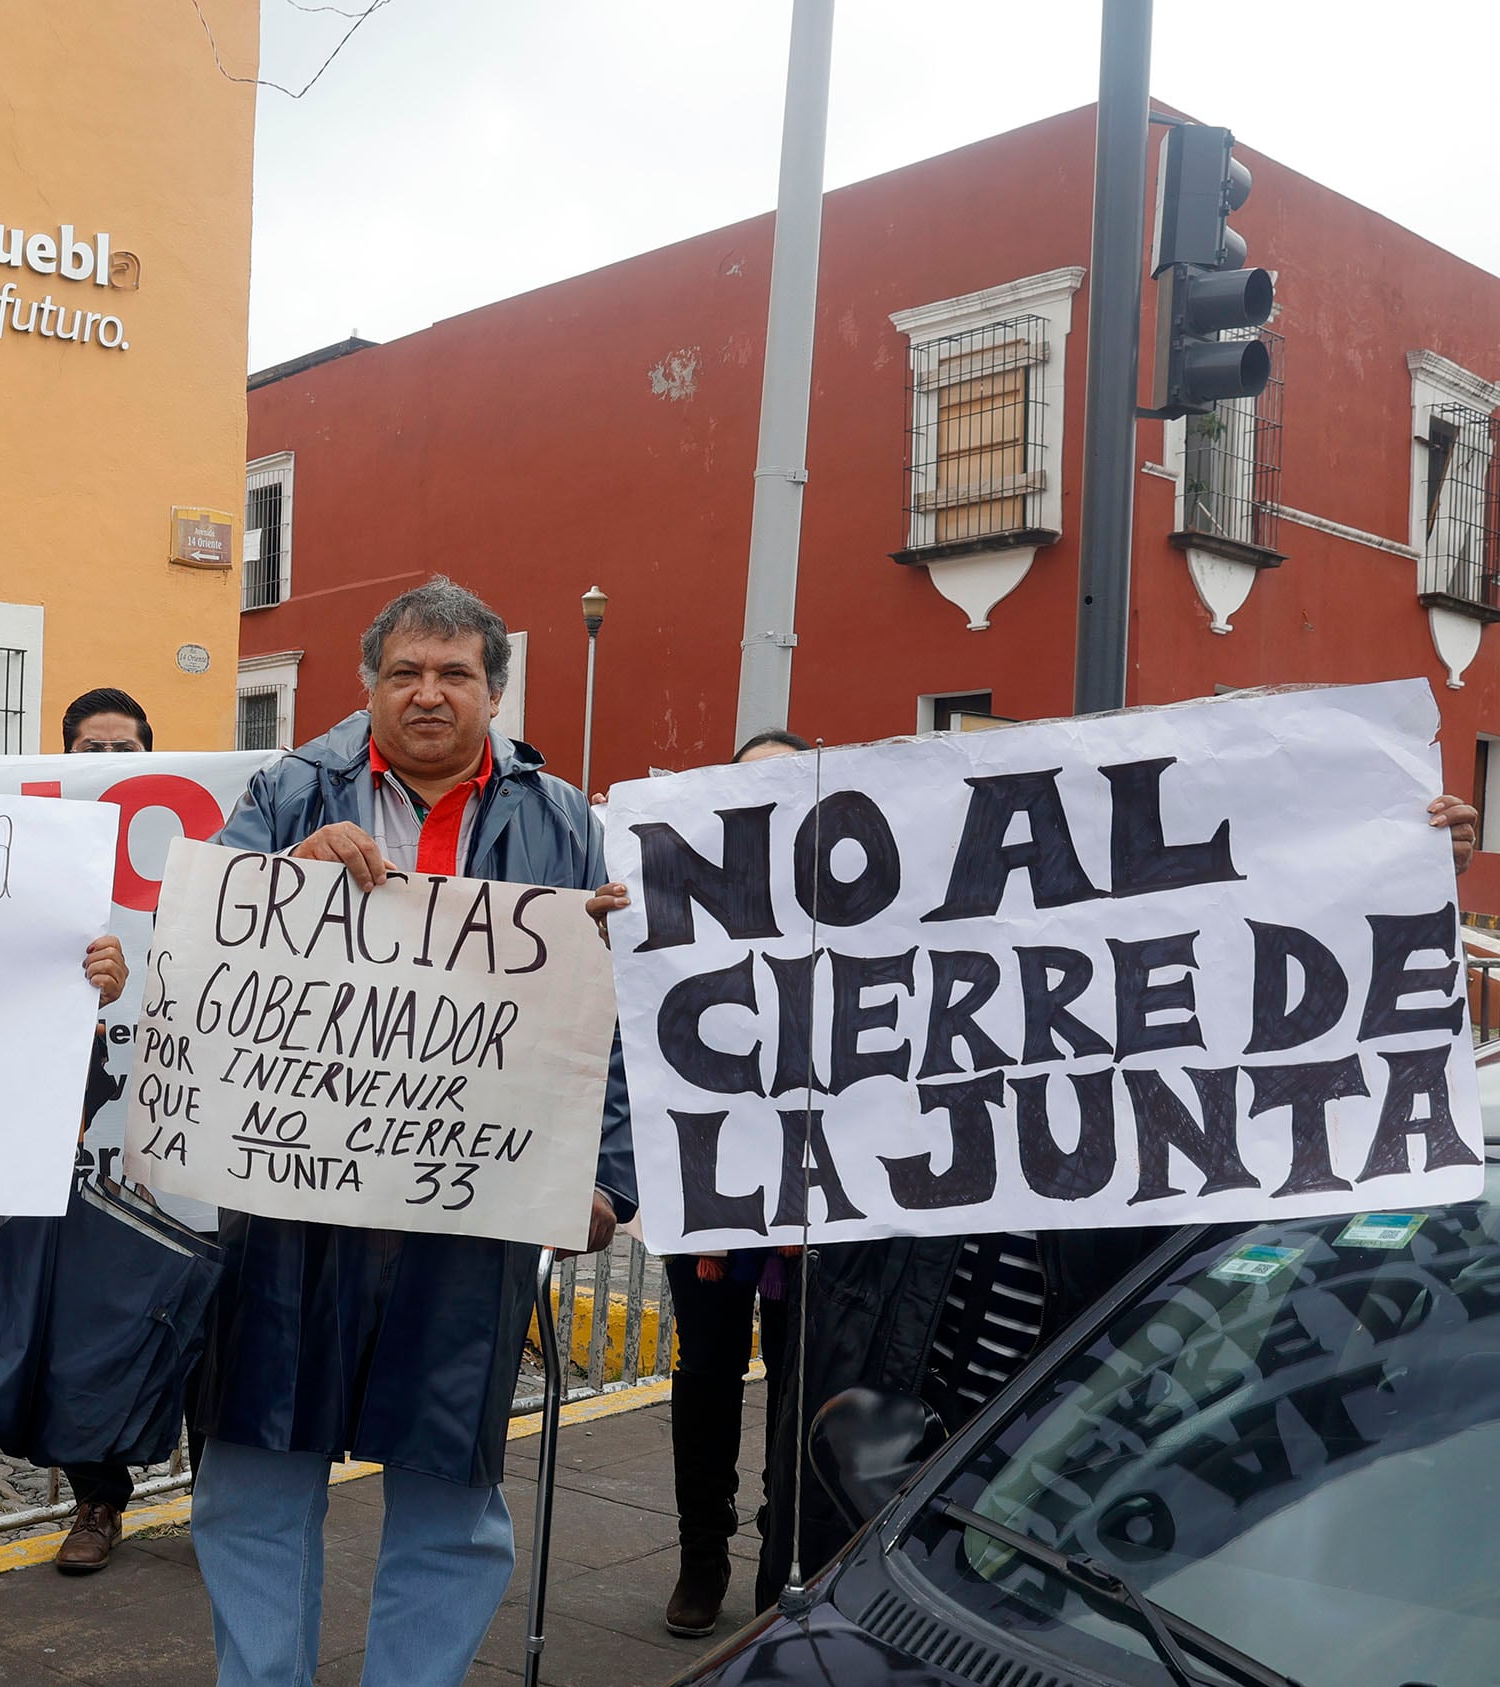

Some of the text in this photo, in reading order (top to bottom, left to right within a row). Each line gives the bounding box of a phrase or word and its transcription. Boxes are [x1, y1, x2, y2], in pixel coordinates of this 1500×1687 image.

[188, 536, 222, 550] 14 Oriente
[629, 756, 1247, 953] NO AL
[215, 852, 557, 975] GRACIAS
[196, 961, 520, 1070] GOBERNADOR
[657, 902, 1465, 1098] CIERRE DE
[139, 1073, 202, 1124] QUE
[241, 1101, 309, 1143] NO
[346, 1116, 532, 1162] CIERREN
[143, 1026, 194, 1075] POR
[219, 1046, 470, 1112] INTERVENIR
[141, 1126, 188, 1166] LA
[227, 1146, 364, 1192] JUNTA
[405, 1162, 481, 1210] 33
[666, 1043, 1484, 1238] LA JUNTA
